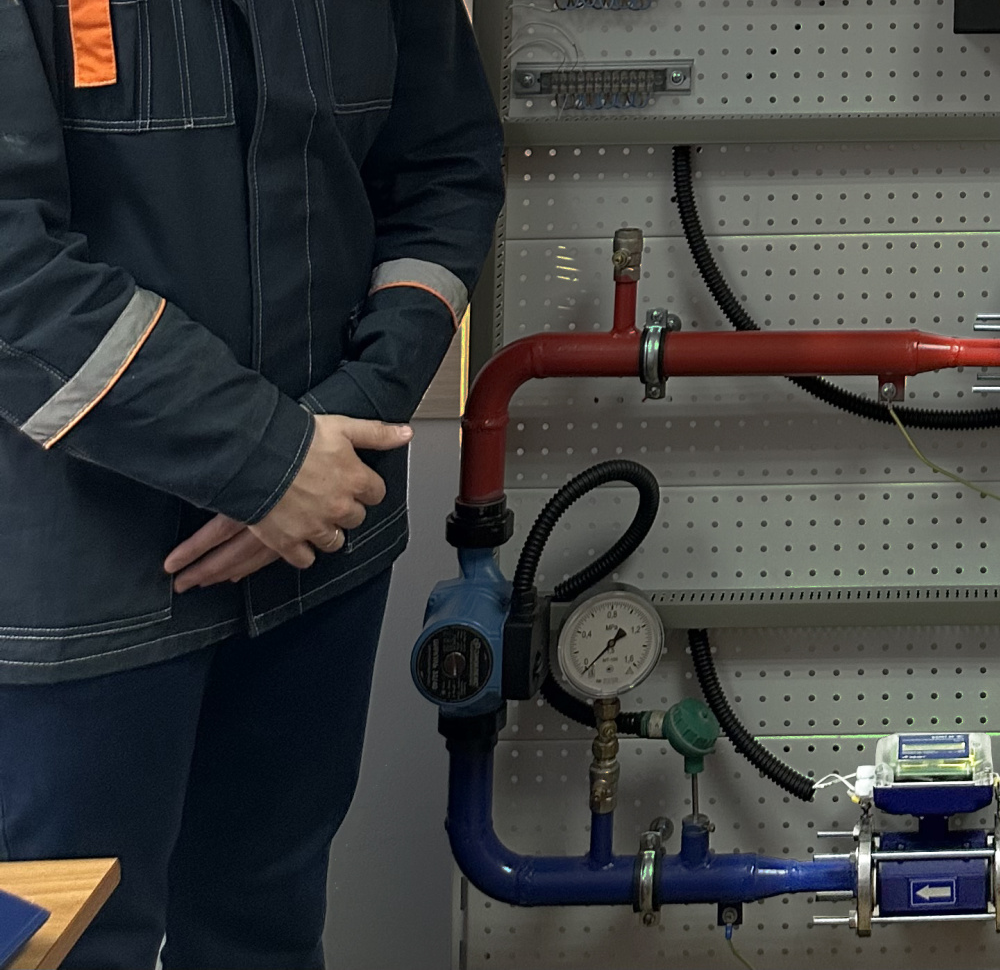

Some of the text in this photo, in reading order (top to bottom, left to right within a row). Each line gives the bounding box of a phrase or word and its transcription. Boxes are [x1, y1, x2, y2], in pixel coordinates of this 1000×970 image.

[607, 611, 617, 619] 0,8
[631, 625, 641, 634] 1,2
[581, 631, 592, 639] 0,4
[624, 655, 634, 663] 1,6
